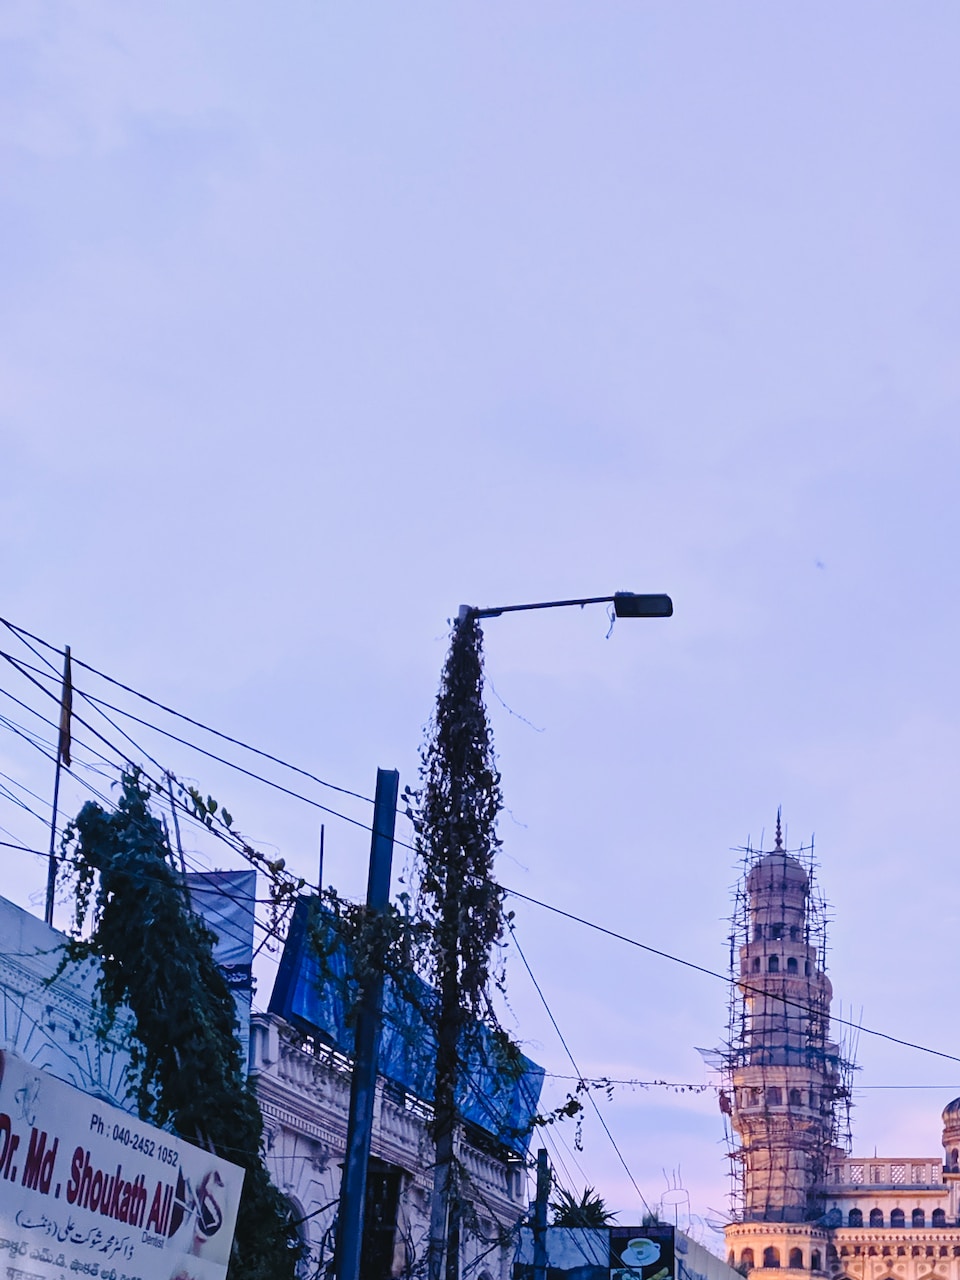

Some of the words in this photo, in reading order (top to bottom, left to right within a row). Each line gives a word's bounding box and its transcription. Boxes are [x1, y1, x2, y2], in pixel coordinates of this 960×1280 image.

[112, 1124, 156, 1158] 040-2452
[157, 1145, 179, 1167] 1052
[66, 1146, 148, 1229] Shoukath
[141, 1231, 166, 1250] Dentist
